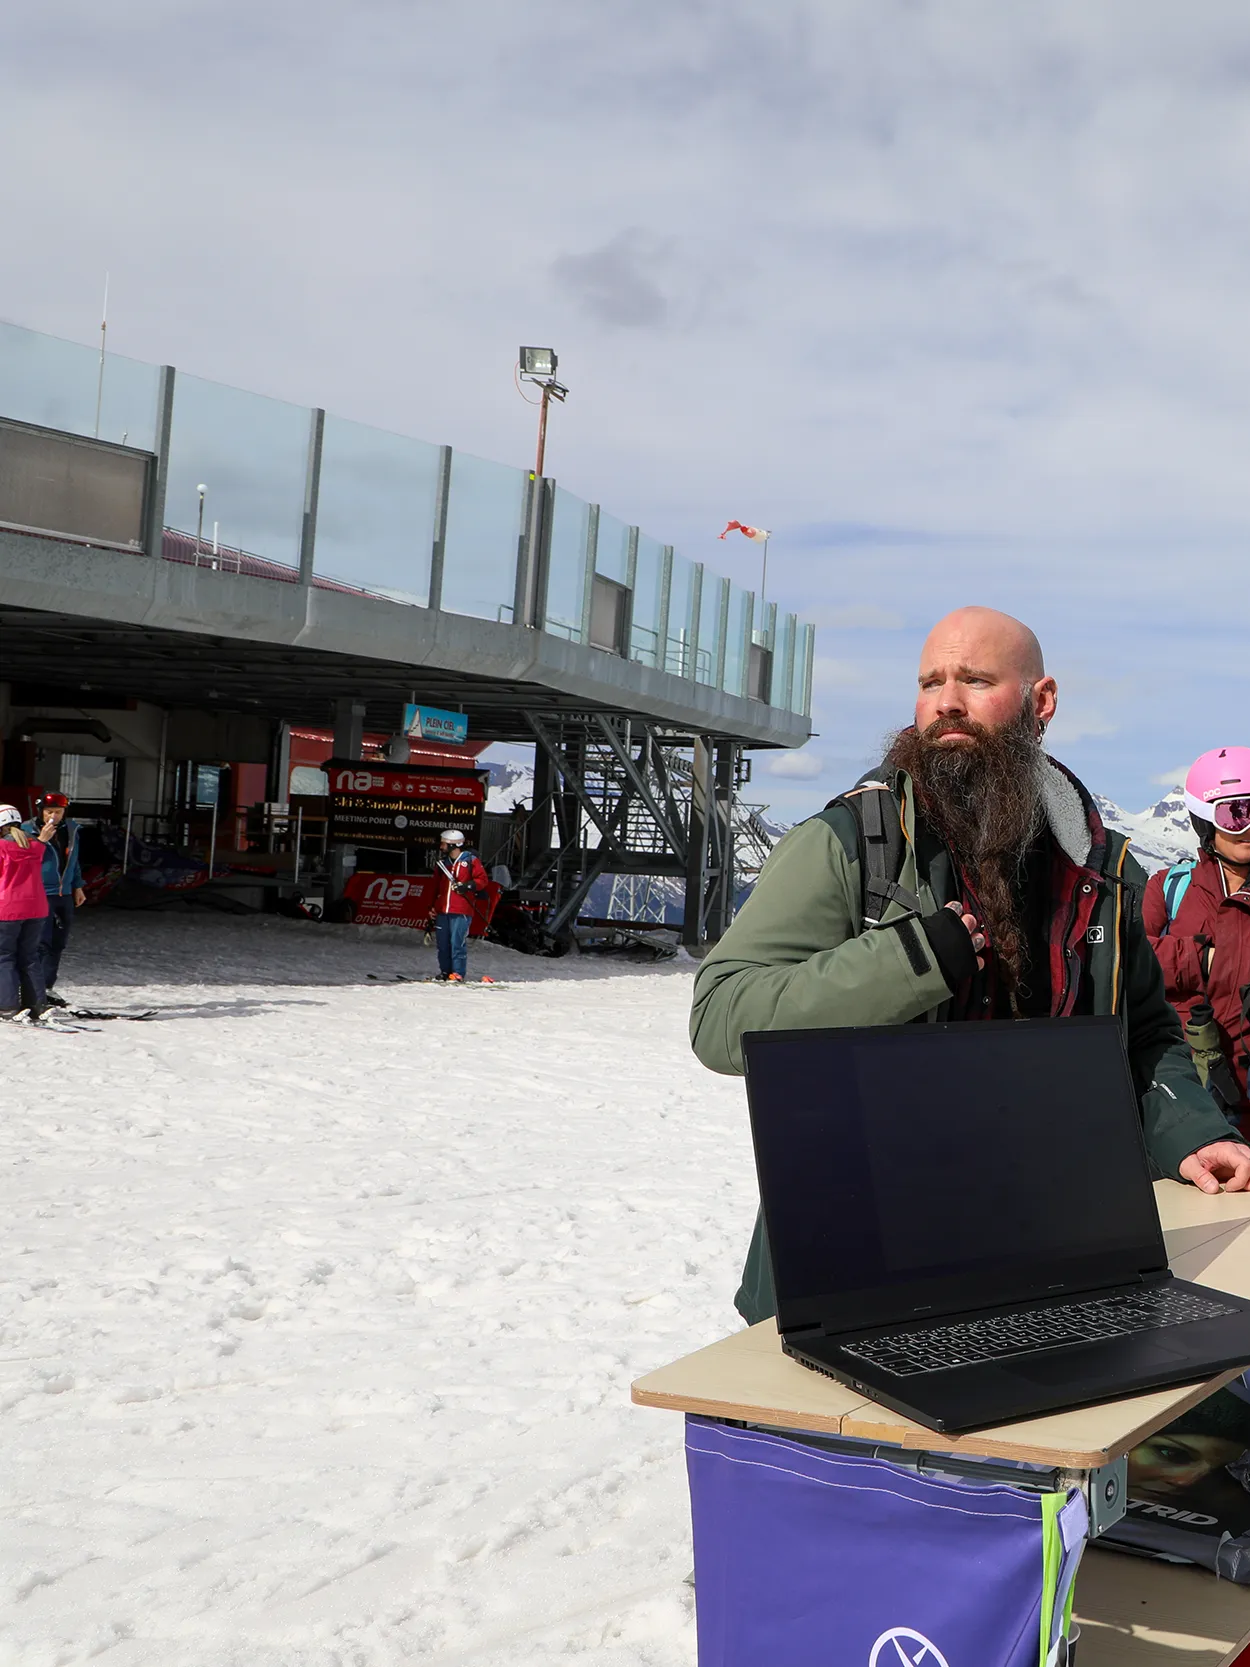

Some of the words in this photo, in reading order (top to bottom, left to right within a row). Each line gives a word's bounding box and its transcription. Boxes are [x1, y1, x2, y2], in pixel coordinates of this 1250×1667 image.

[425, 716, 443, 729] PLEIN
[443, 720, 455, 731] CIEL
[334, 796, 353, 807] Ski
[367, 800, 434, 813] Snowboard
[437, 803, 477, 816] School
[334, 815, 368, 824] MEETING
[368, 816, 392, 825] POINT
[409, 820, 475, 831] RASSEMBLEMENT
[354, 913, 430, 929] onthemount
